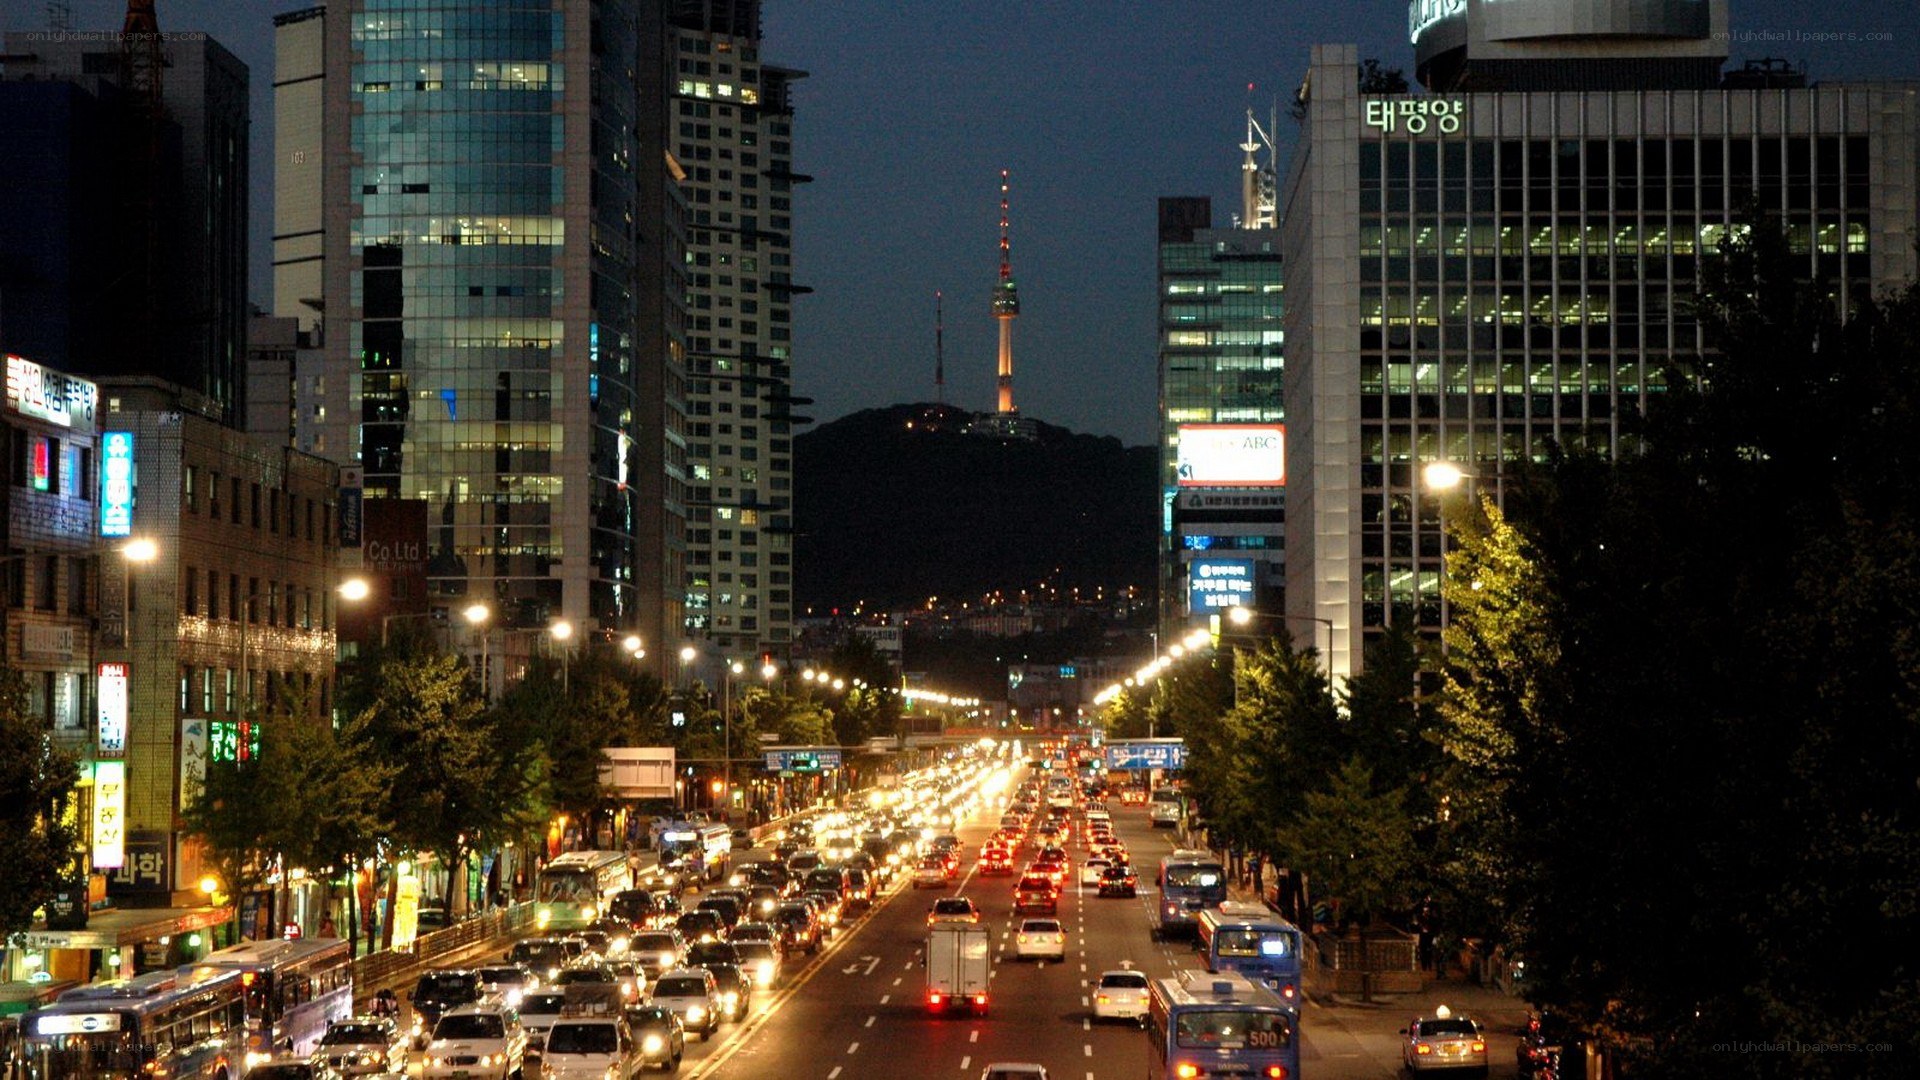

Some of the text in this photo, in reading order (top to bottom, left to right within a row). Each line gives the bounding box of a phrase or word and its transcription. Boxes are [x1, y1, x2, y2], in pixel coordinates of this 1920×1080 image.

[1366, 100, 1463, 133] 태평양
[1243, 436, 1277, 449] ABC
[99, 784, 119, 845] 부동산
[100, 852, 163, 885] 과학
[1250, 1031, 1277, 1046] 500
